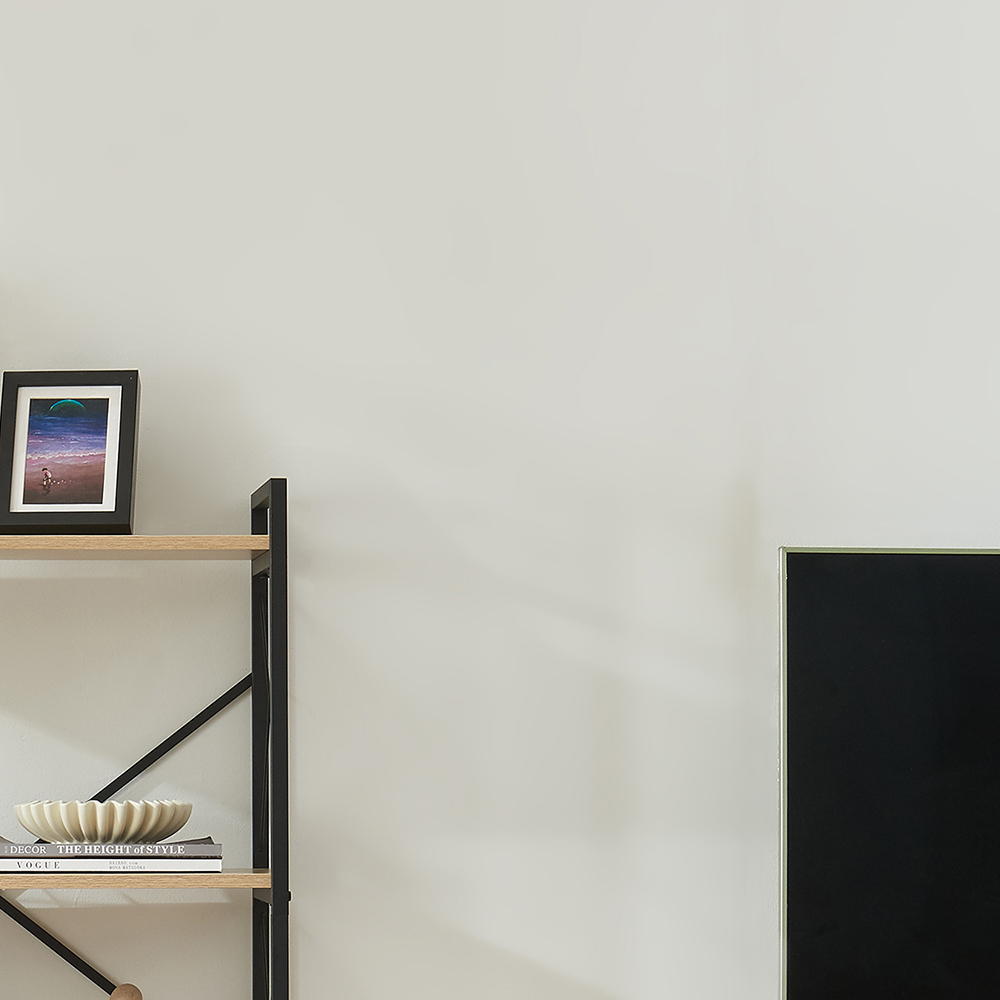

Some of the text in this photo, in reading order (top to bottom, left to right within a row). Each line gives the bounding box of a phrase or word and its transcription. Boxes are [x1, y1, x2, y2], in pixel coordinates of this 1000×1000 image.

[10, 845, 186, 854] DECOR THE HEIGHT of STYLE
[16, 861, 60, 869] VOGUE
